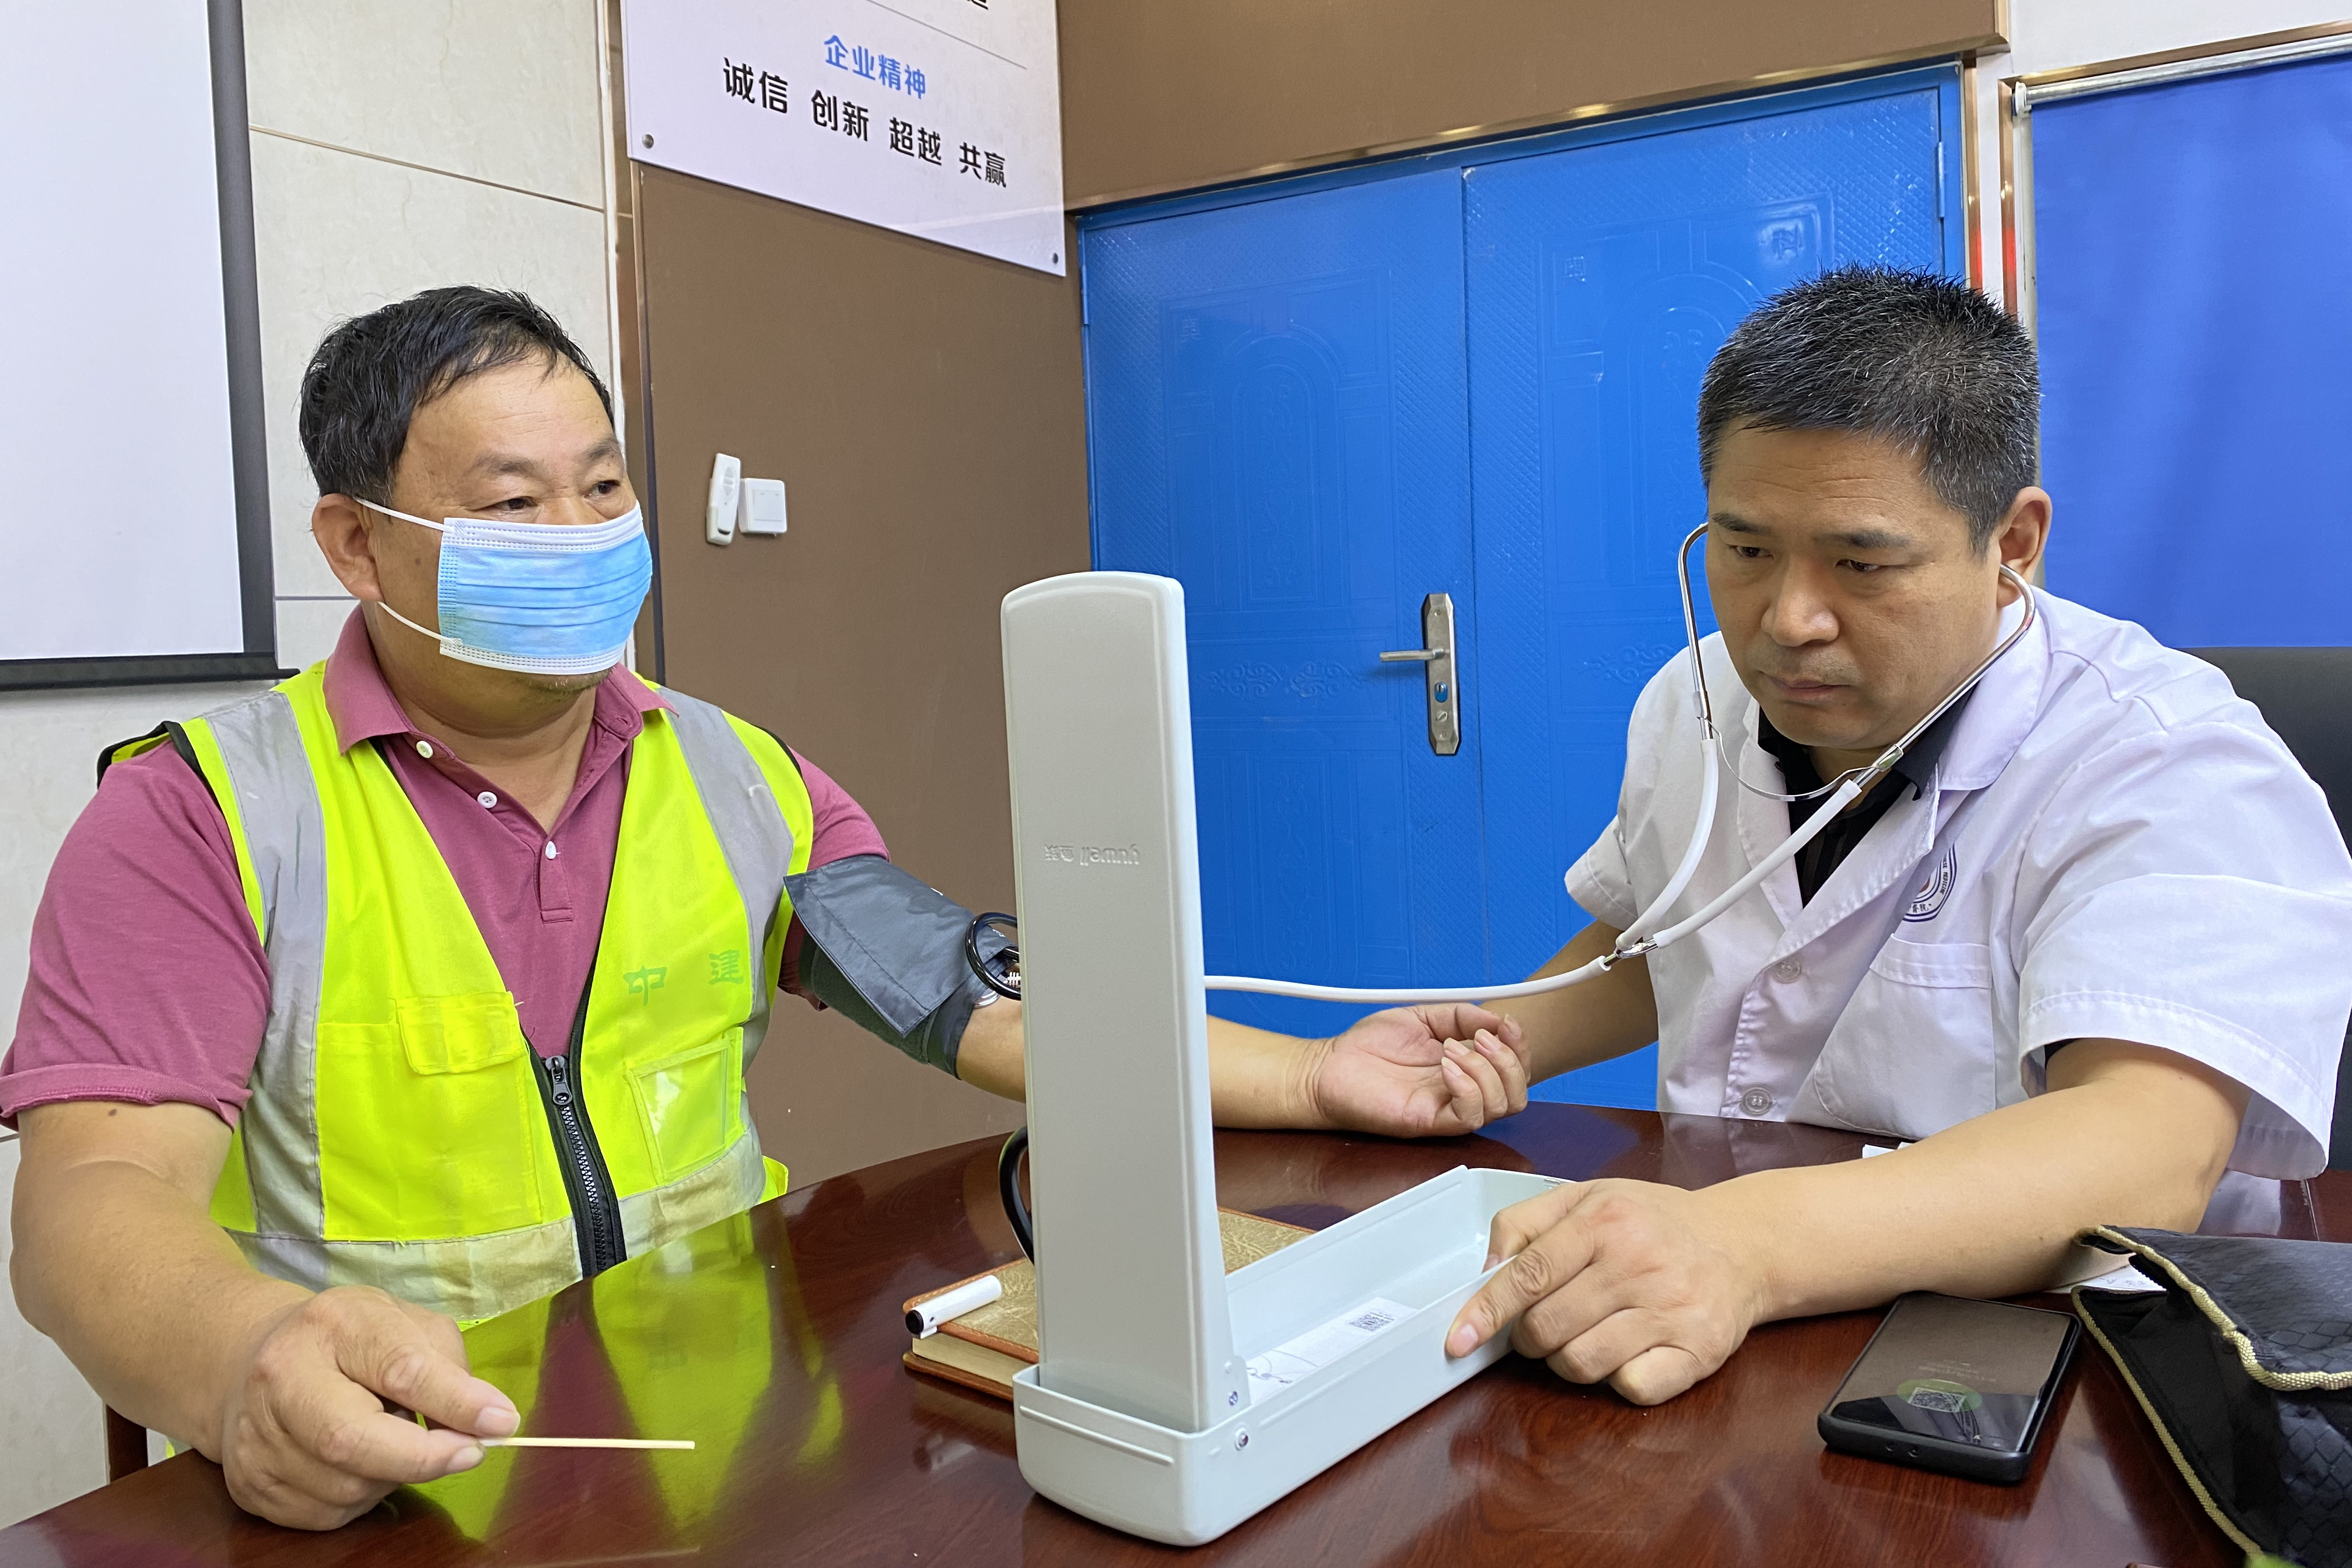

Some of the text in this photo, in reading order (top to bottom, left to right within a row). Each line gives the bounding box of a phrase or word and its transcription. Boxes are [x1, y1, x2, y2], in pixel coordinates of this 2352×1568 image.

[824, 34, 926, 99] 企业精神
[723, 57, 1007, 188] 诚信 创新 超越 共赢
[1080, 844, 1140, 866] yuwell
[1939, 872, 1948, 895] MEDICINE
